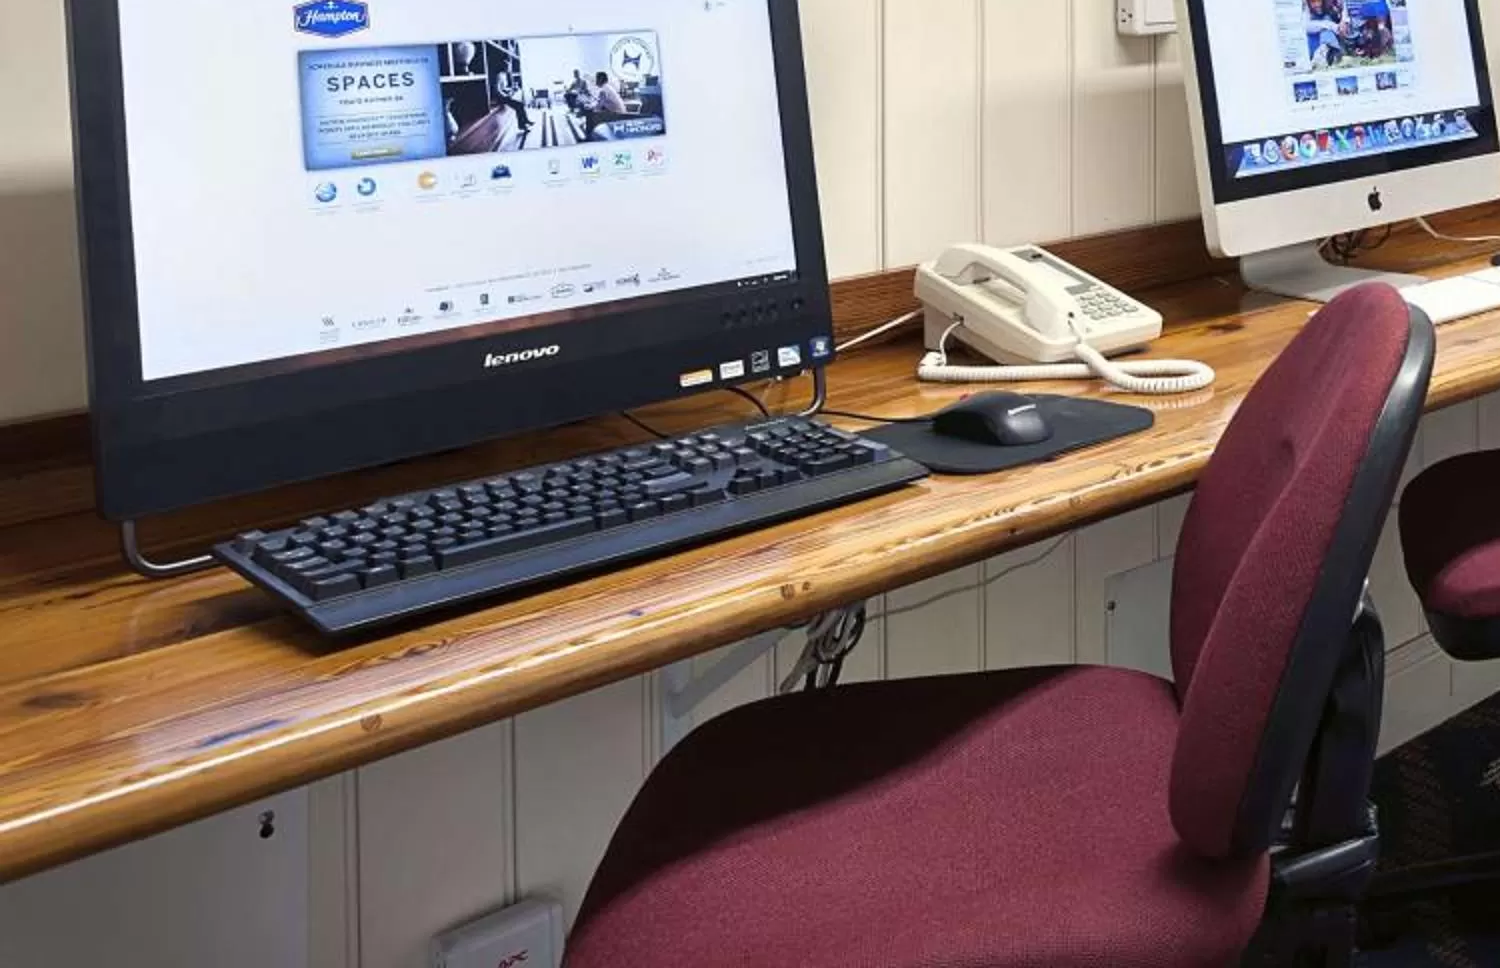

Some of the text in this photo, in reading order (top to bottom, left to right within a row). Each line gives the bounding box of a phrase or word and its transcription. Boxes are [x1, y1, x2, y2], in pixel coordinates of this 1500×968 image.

[298, 9, 364, 27] Hampton
[327, 72, 415, 92] SPACES
[484, 344, 560, 367] lenovo
